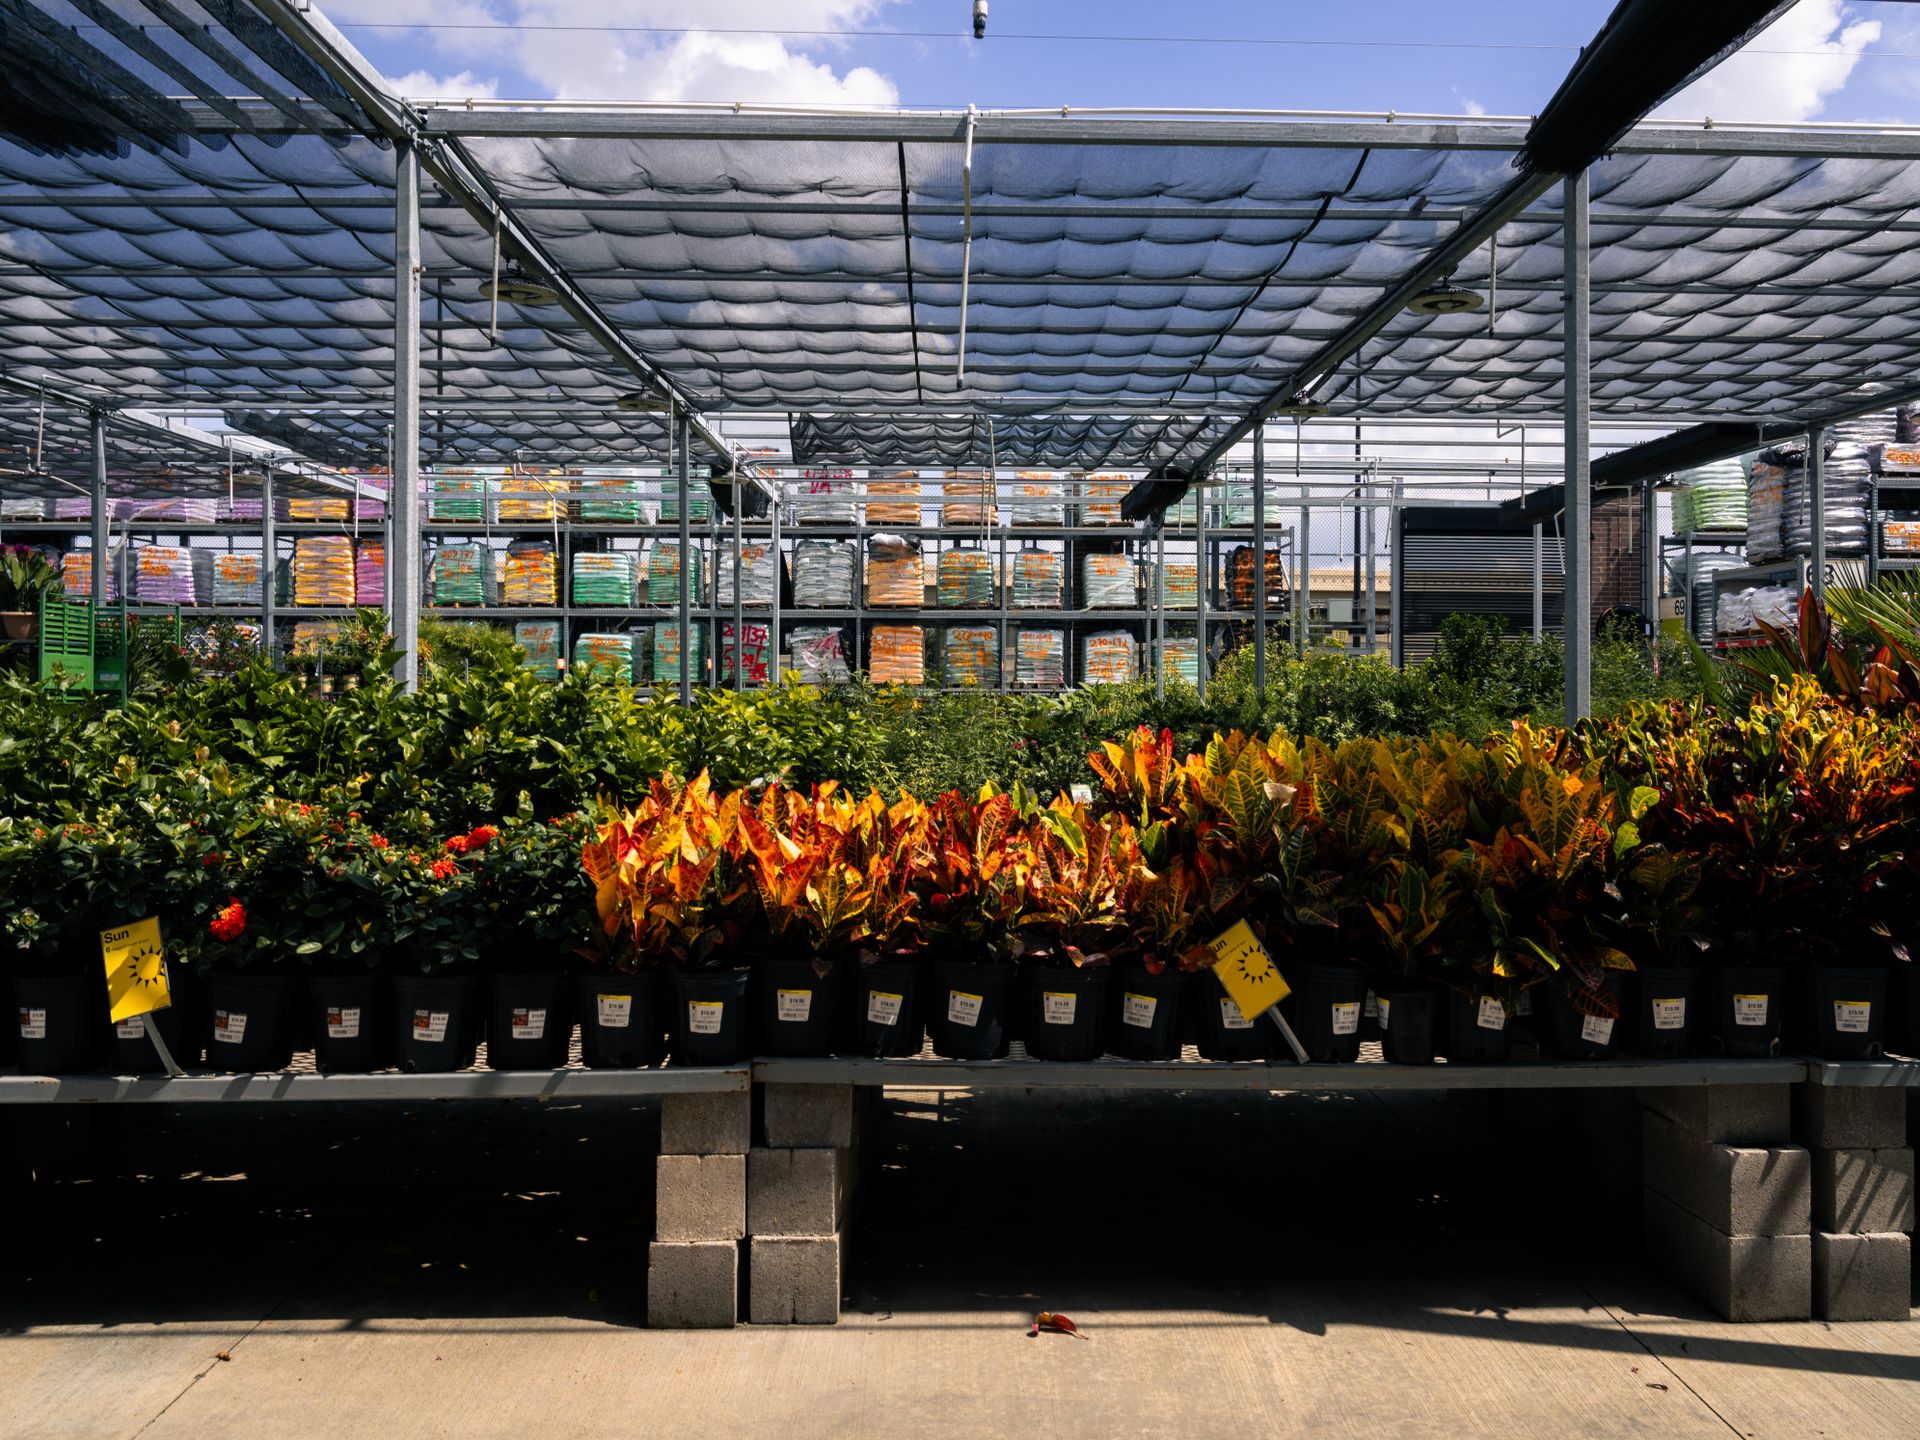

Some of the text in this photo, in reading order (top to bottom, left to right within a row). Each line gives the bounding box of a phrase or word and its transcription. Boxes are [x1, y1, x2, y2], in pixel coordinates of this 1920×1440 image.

[1674, 599, 1686, 616] 69
[104, 930, 129, 944] Sun
[1212, 939, 1228, 953] un
